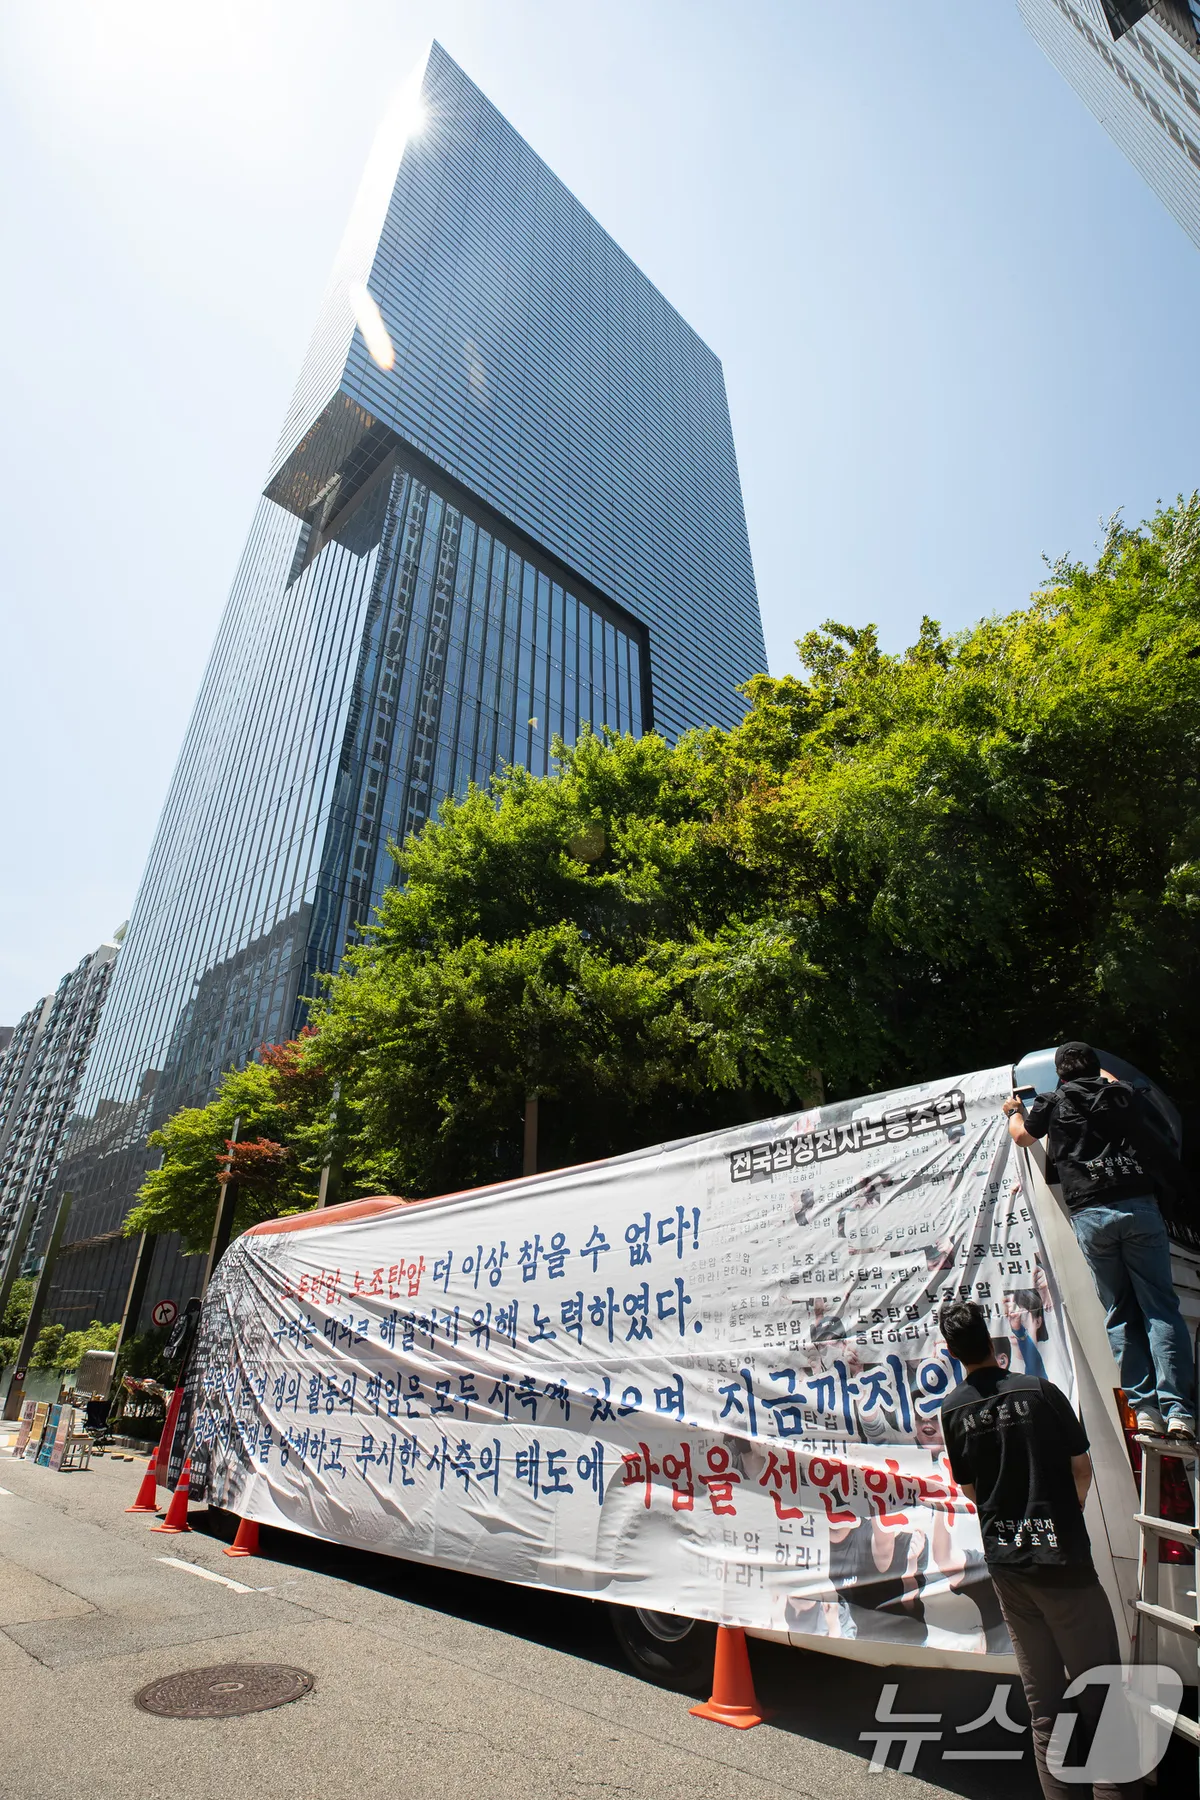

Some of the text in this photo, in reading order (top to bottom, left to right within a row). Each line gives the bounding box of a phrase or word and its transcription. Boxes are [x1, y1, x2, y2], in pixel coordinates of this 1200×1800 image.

[731, 1090, 966, 1182] 전국삼성전자노동조합
[349, 1255, 426, 1300] 노조탄압
[433, 1250, 453, 1293] 더
[462, 1241, 509, 1289] 이상
[517, 1232, 571, 1283] 참을
[580, 1225, 611, 1273] 수
[625, 1205, 701, 1267] 없다!
[961, 1242, 1021, 1258] 노조탄압
[925, 1282, 991, 1303] 노조탄압
[273, 1313, 317, 1350] 우리는
[324, 1314, 369, 1349] 대화로
[379, 1306, 460, 1351] 해결하기
[470, 1299, 518, 1351] 위해
[528, 1277, 702, 1345] 노력하였다.
[857, 1304, 920, 1324] 노조탄압
[752, 1320, 801, 1339] 노조탄압
[856, 1323, 930, 1345] 중단하라!
[272, 1372, 301, 1413] 쟁의
[306, 1372, 357, 1416] 활동의
[364, 1371, 424, 1418] 책임은
[431, 1373, 480, 1420] 모두
[488, 1374, 570, 1422] 사측에
[720, 1349, 968, 1437] 지금까지의
[963, 1400, 1030, 1431] NSEU
[356, 1433, 421, 1486] 무시한
[426, 1436, 500, 1496] 사측의
[515, 1439, 604, 1506] 태도에
[621, 1442, 741, 1516] 파업을
[759, 1447, 976, 1527] 선언한다.
[994, 1518, 1055, 1532] 전국삼성전자
[998, 1533, 1058, 1548] 노동조합
